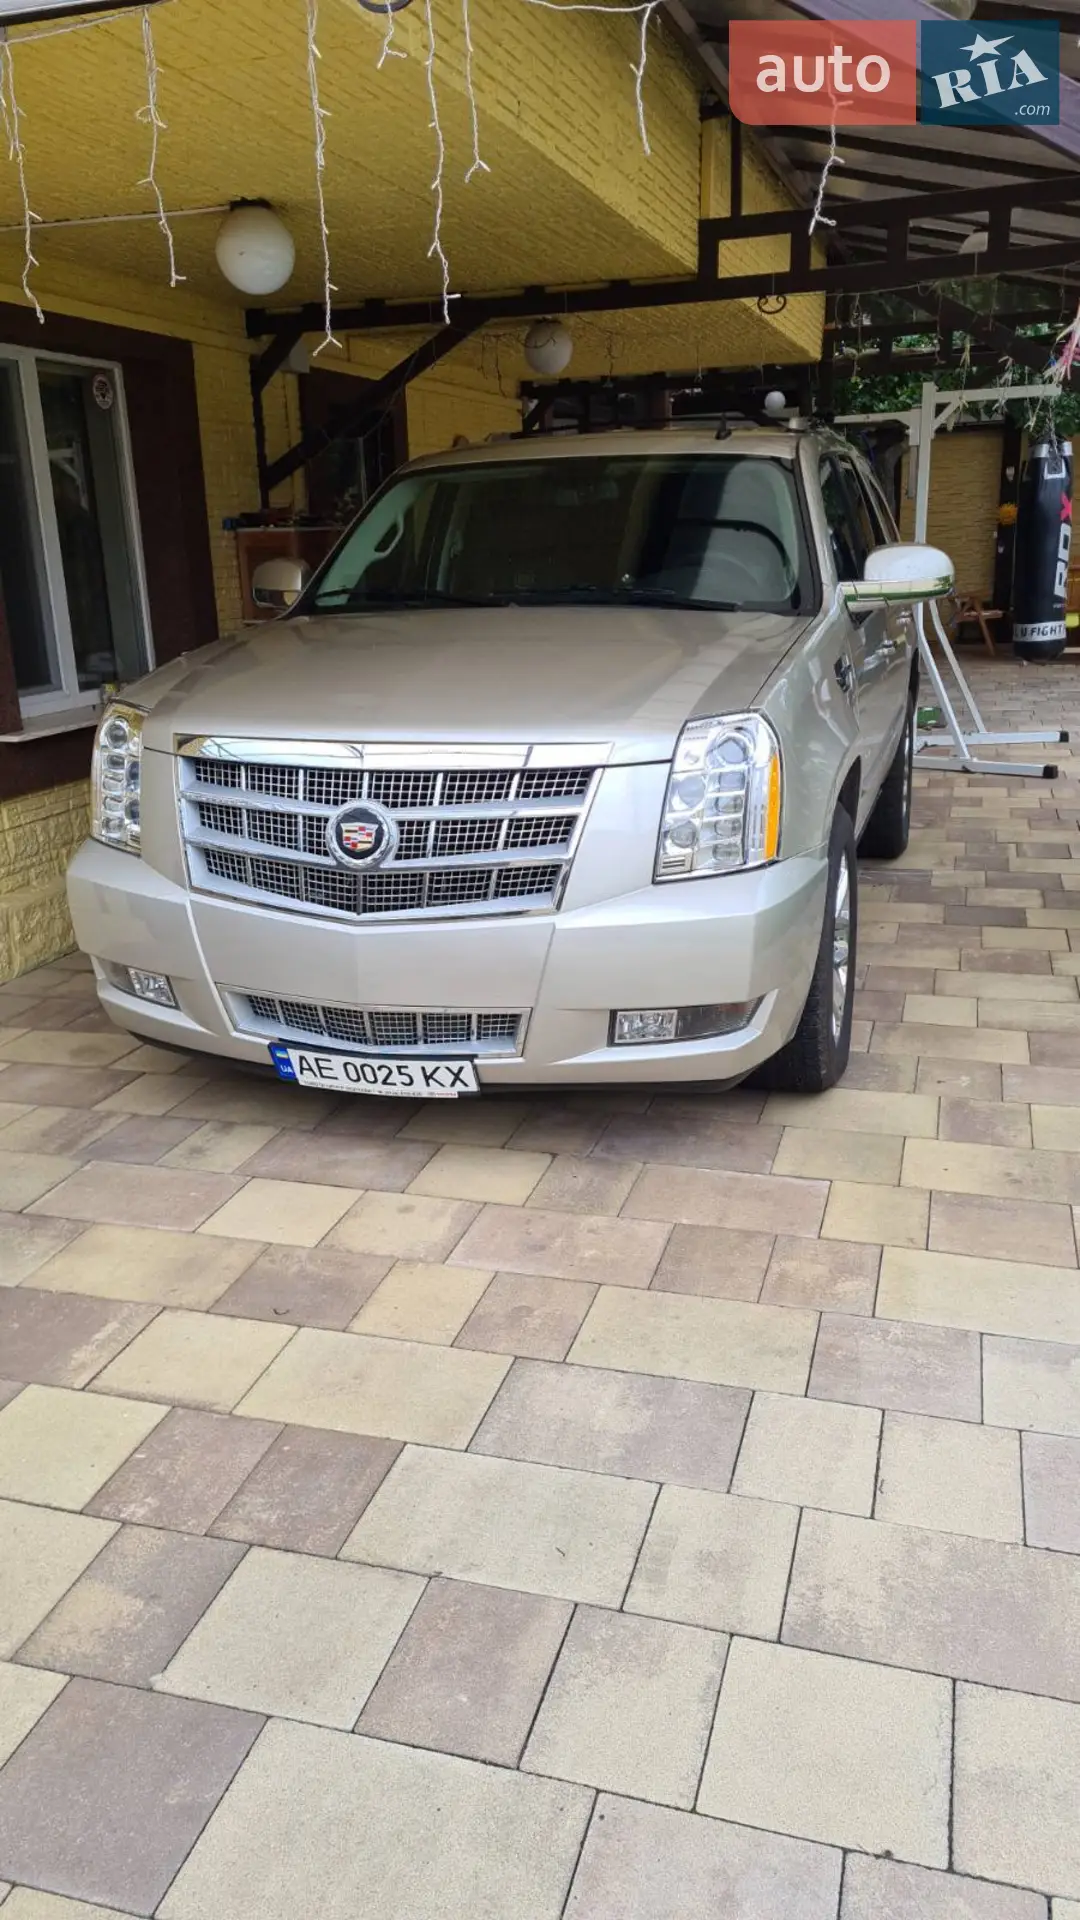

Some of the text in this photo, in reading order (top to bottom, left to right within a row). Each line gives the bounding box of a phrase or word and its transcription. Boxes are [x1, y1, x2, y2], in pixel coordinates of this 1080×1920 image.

[299, 1055, 470, 1087] AE 0025 KX
